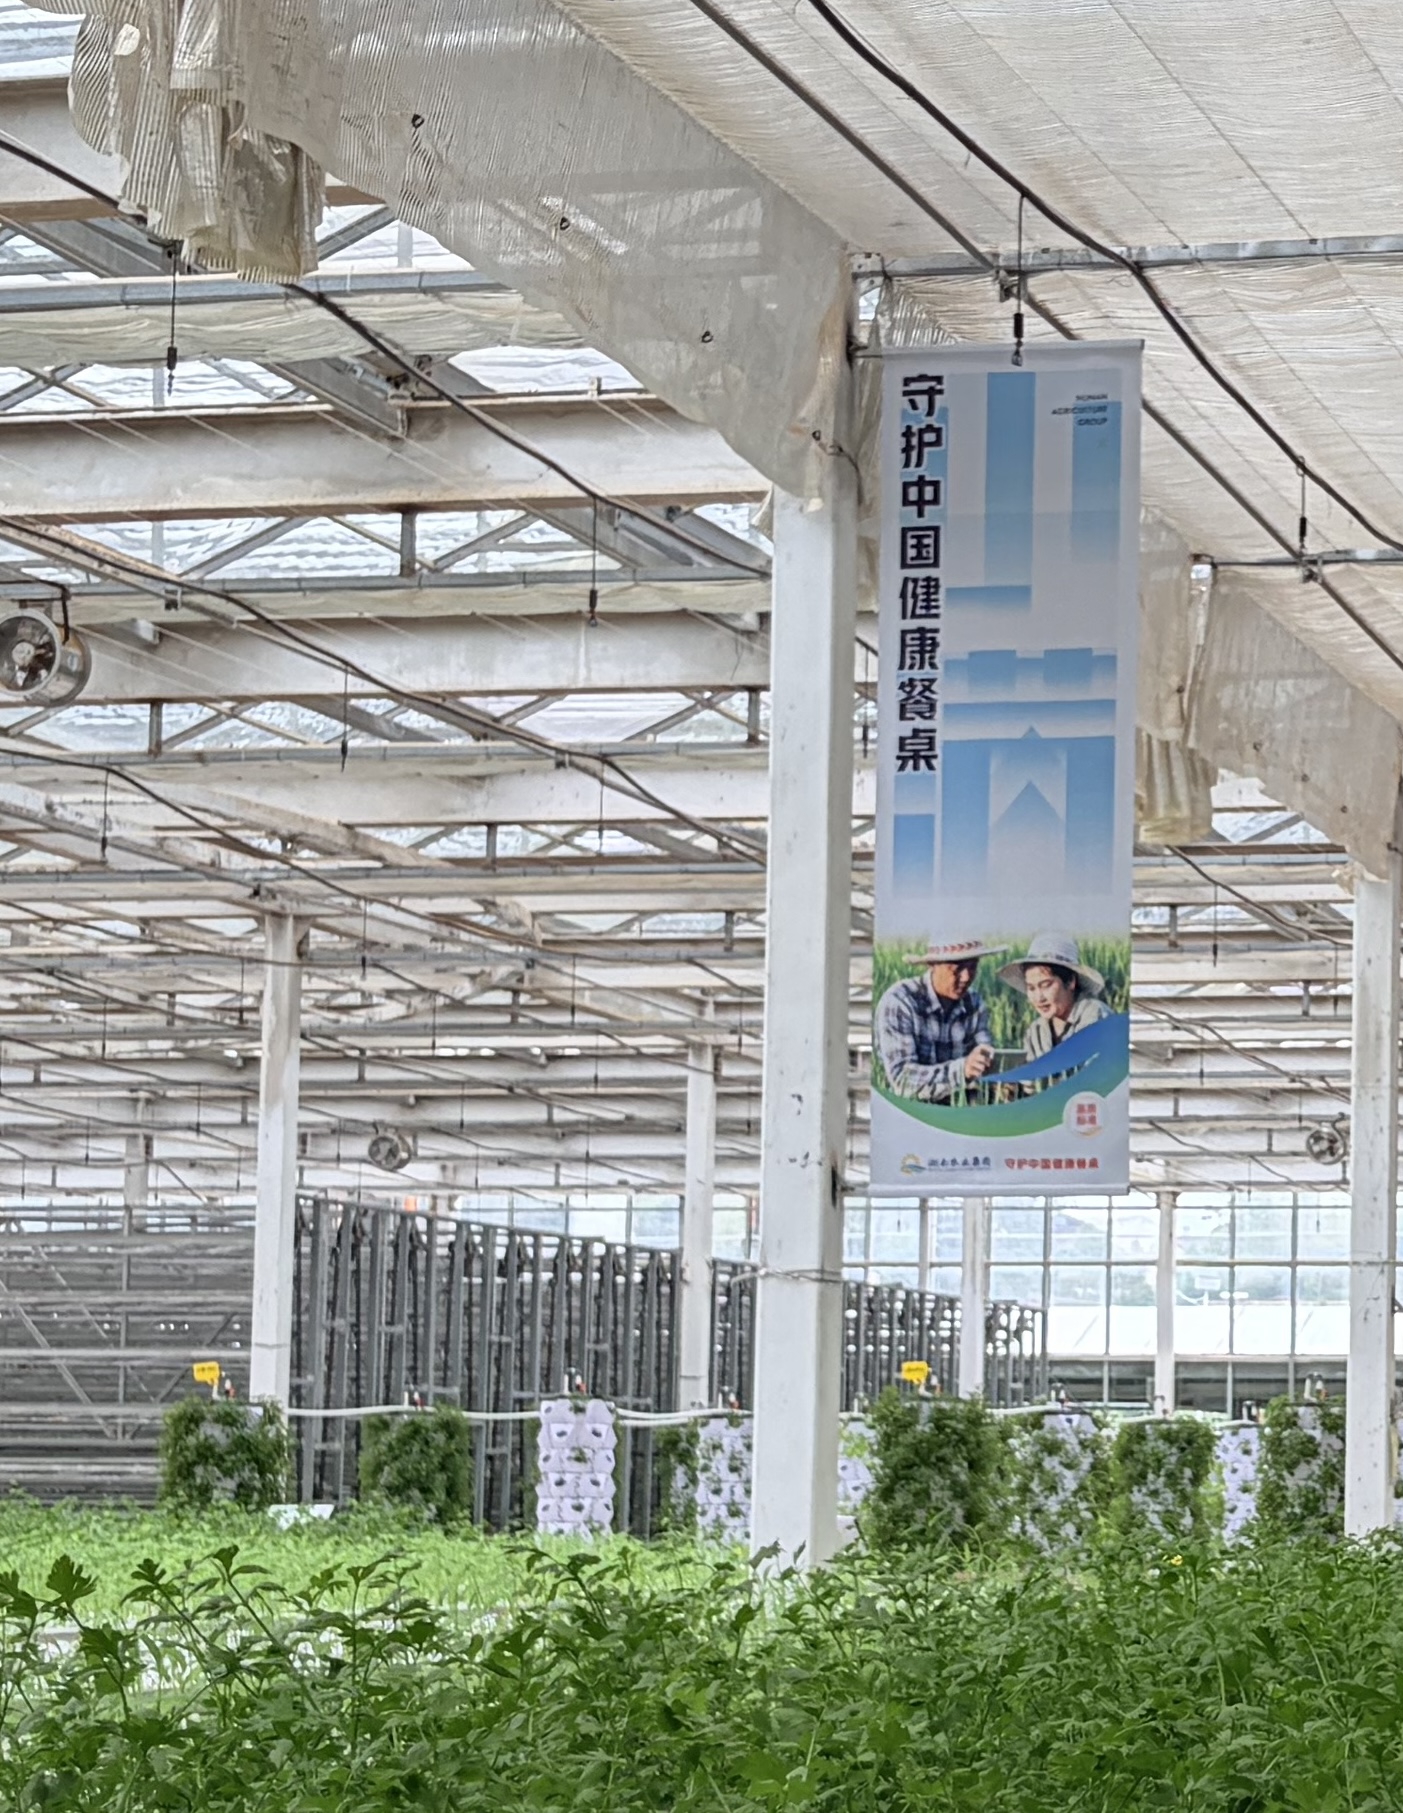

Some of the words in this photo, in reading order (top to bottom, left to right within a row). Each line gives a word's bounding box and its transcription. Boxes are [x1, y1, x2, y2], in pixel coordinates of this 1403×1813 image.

[896, 373, 944, 772] 守护中国健康餐桌
